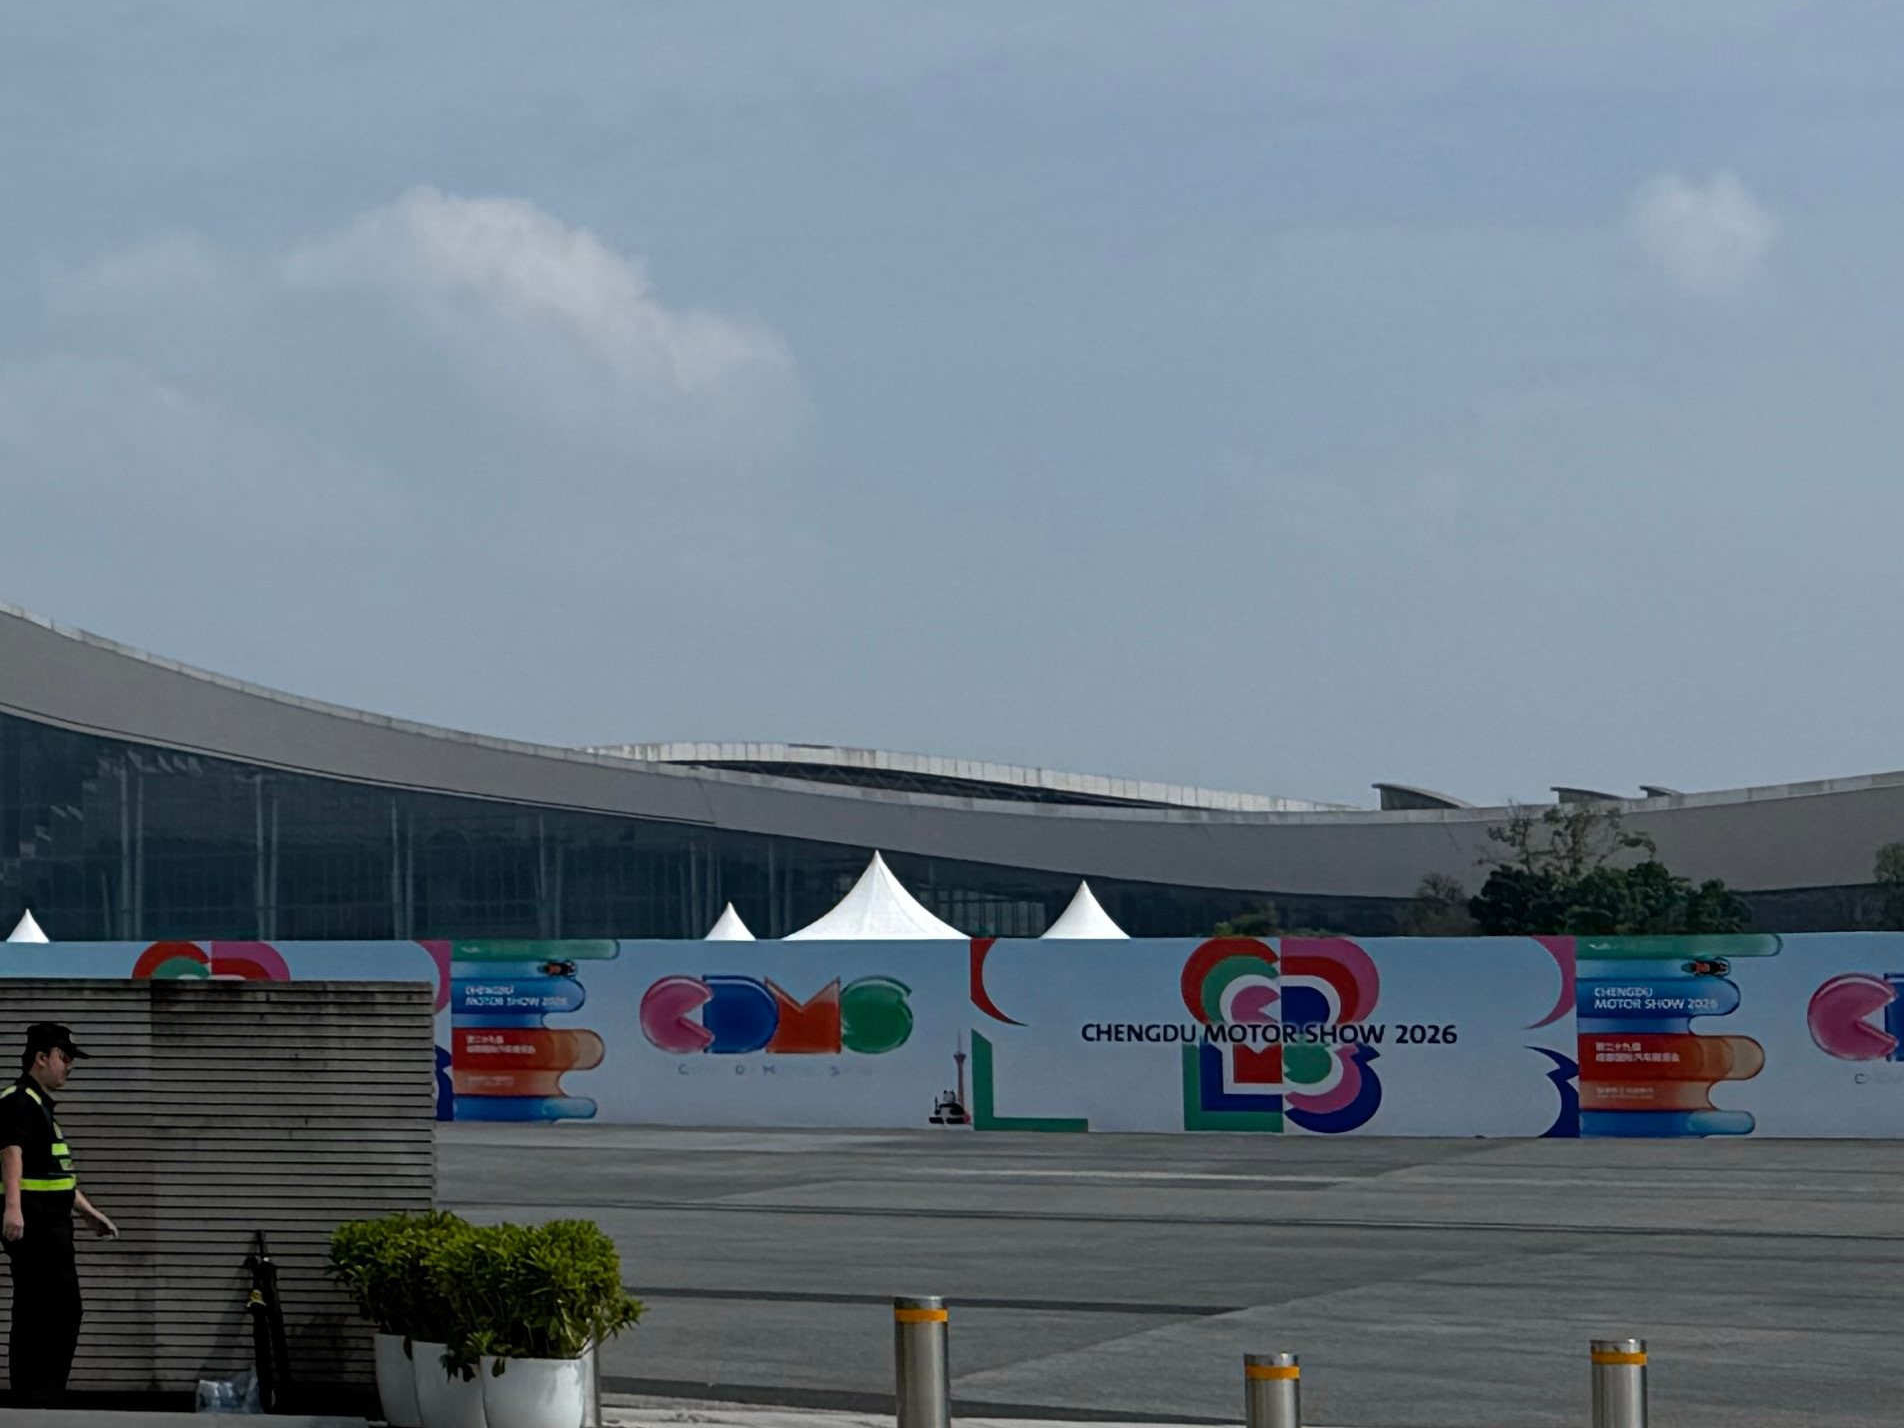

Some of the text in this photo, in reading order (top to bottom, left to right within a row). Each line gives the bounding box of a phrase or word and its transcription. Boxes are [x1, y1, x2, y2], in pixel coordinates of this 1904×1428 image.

[1594, 998, 1641, 1009] MOTOR
[1645, 998, 1684, 1010] SHOW
[1081, 1022, 1458, 1045] CHENGDU MOTOR SHOW 2026
